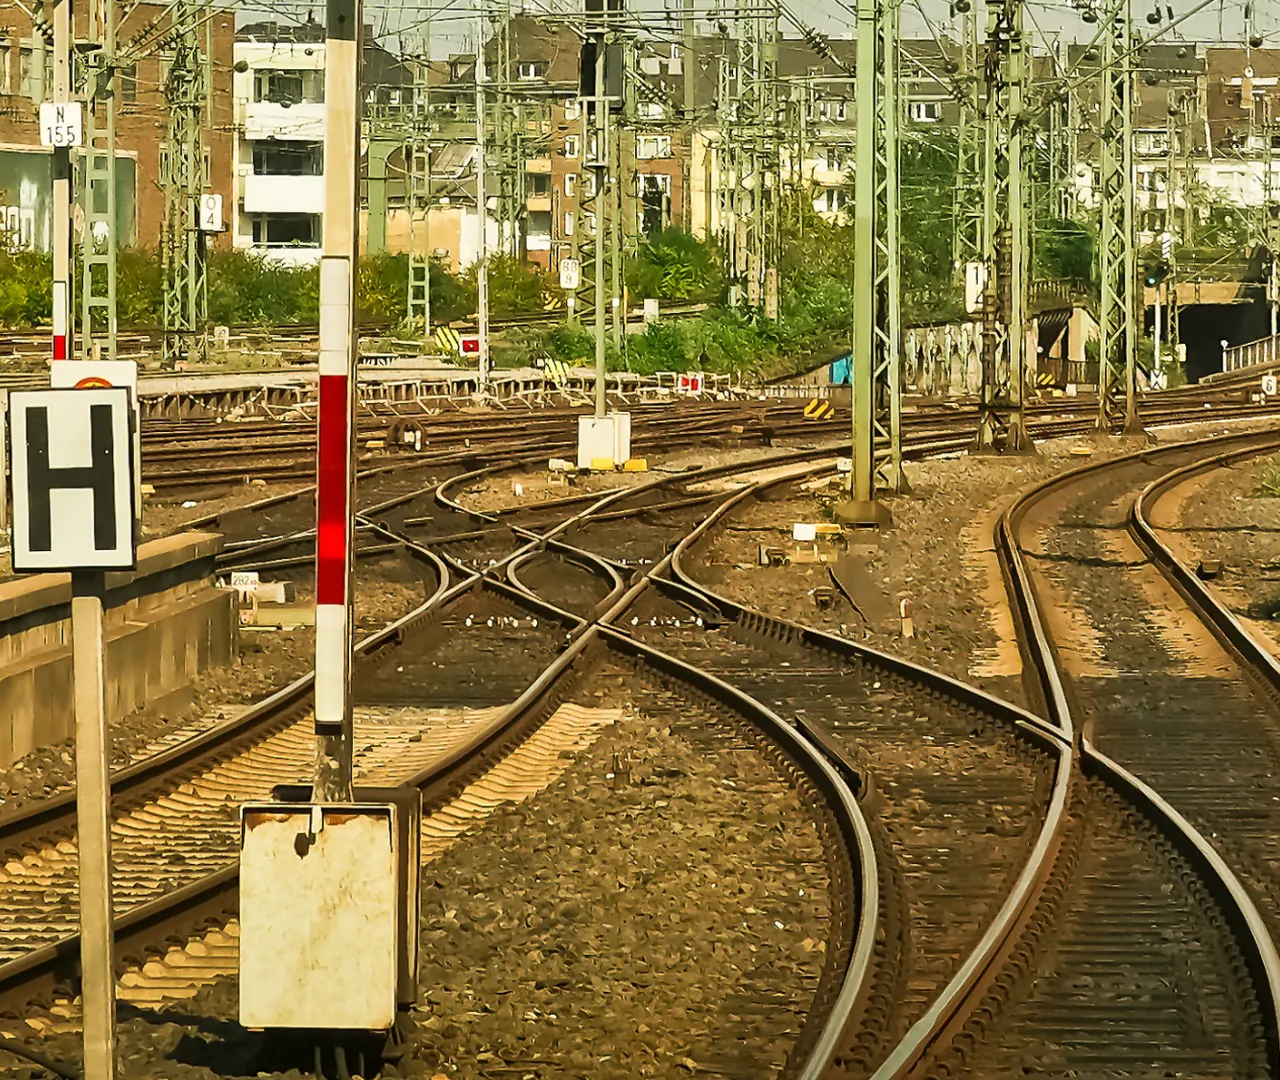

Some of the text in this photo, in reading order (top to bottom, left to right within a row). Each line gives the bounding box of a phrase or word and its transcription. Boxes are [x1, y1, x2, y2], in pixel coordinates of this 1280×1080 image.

[56, 106, 65, 124] N
[47, 125, 76, 144] 155
[25, 403, 117, 551] H
